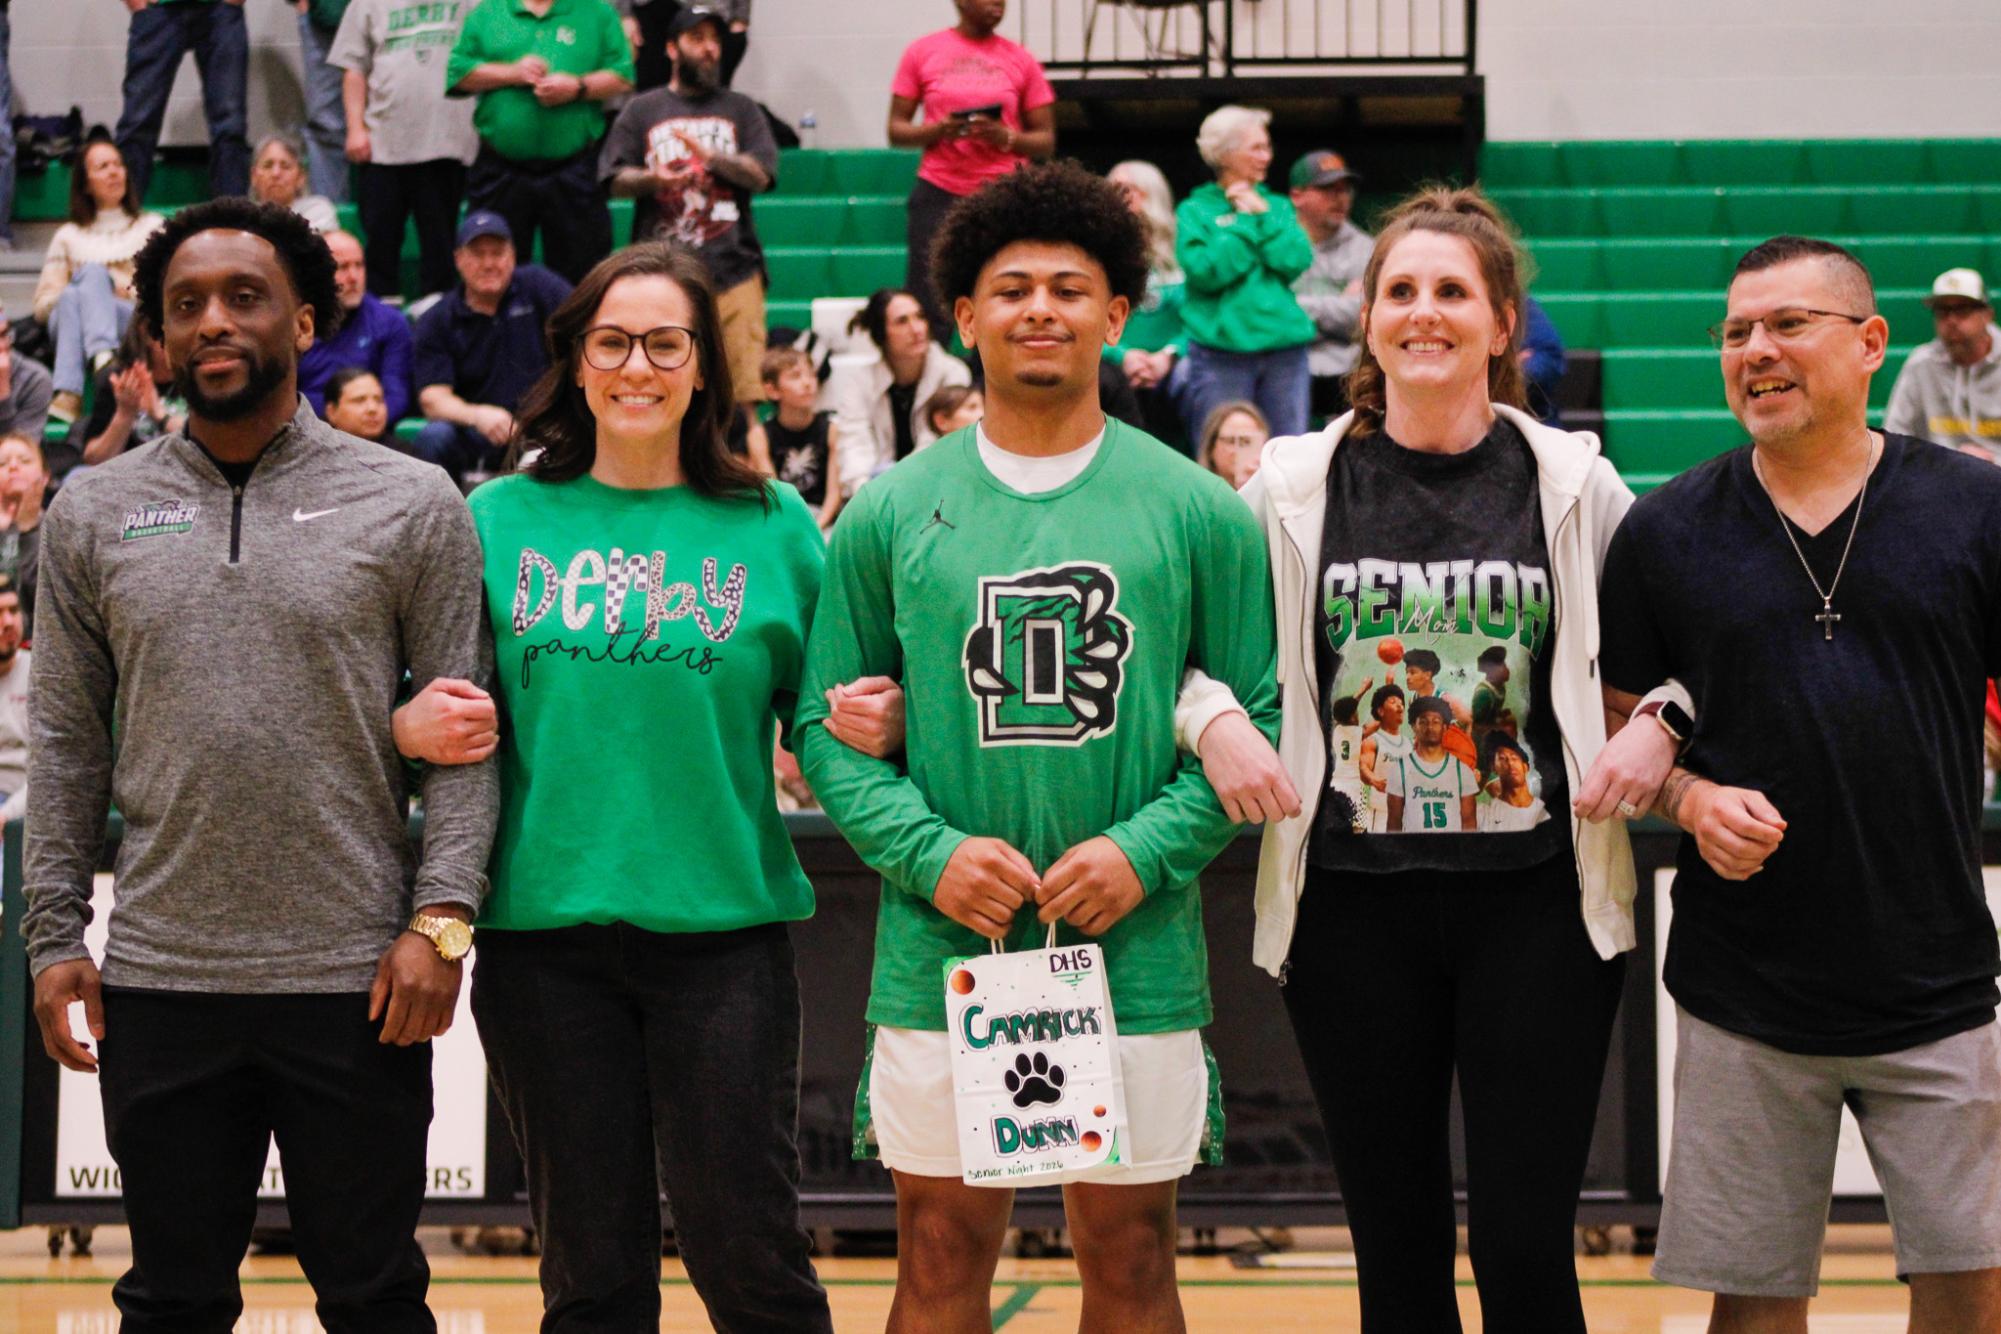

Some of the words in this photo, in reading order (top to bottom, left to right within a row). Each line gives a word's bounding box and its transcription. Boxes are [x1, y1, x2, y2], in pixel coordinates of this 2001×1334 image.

[124, 507, 197, 530] PANTHER
[512, 547, 747, 643] Derby
[1323, 558, 1550, 662] SENIOR
[1402, 602, 1460, 645] Mom
[521, 621, 724, 690] panthers
[1411, 785, 1454, 799] Panthers
[1423, 802, 1447, 829] 15
[1050, 949, 1093, 974] DHS
[959, 1003, 1101, 1051] CAMRICK
[1008, 1163, 1033, 1176] Night
